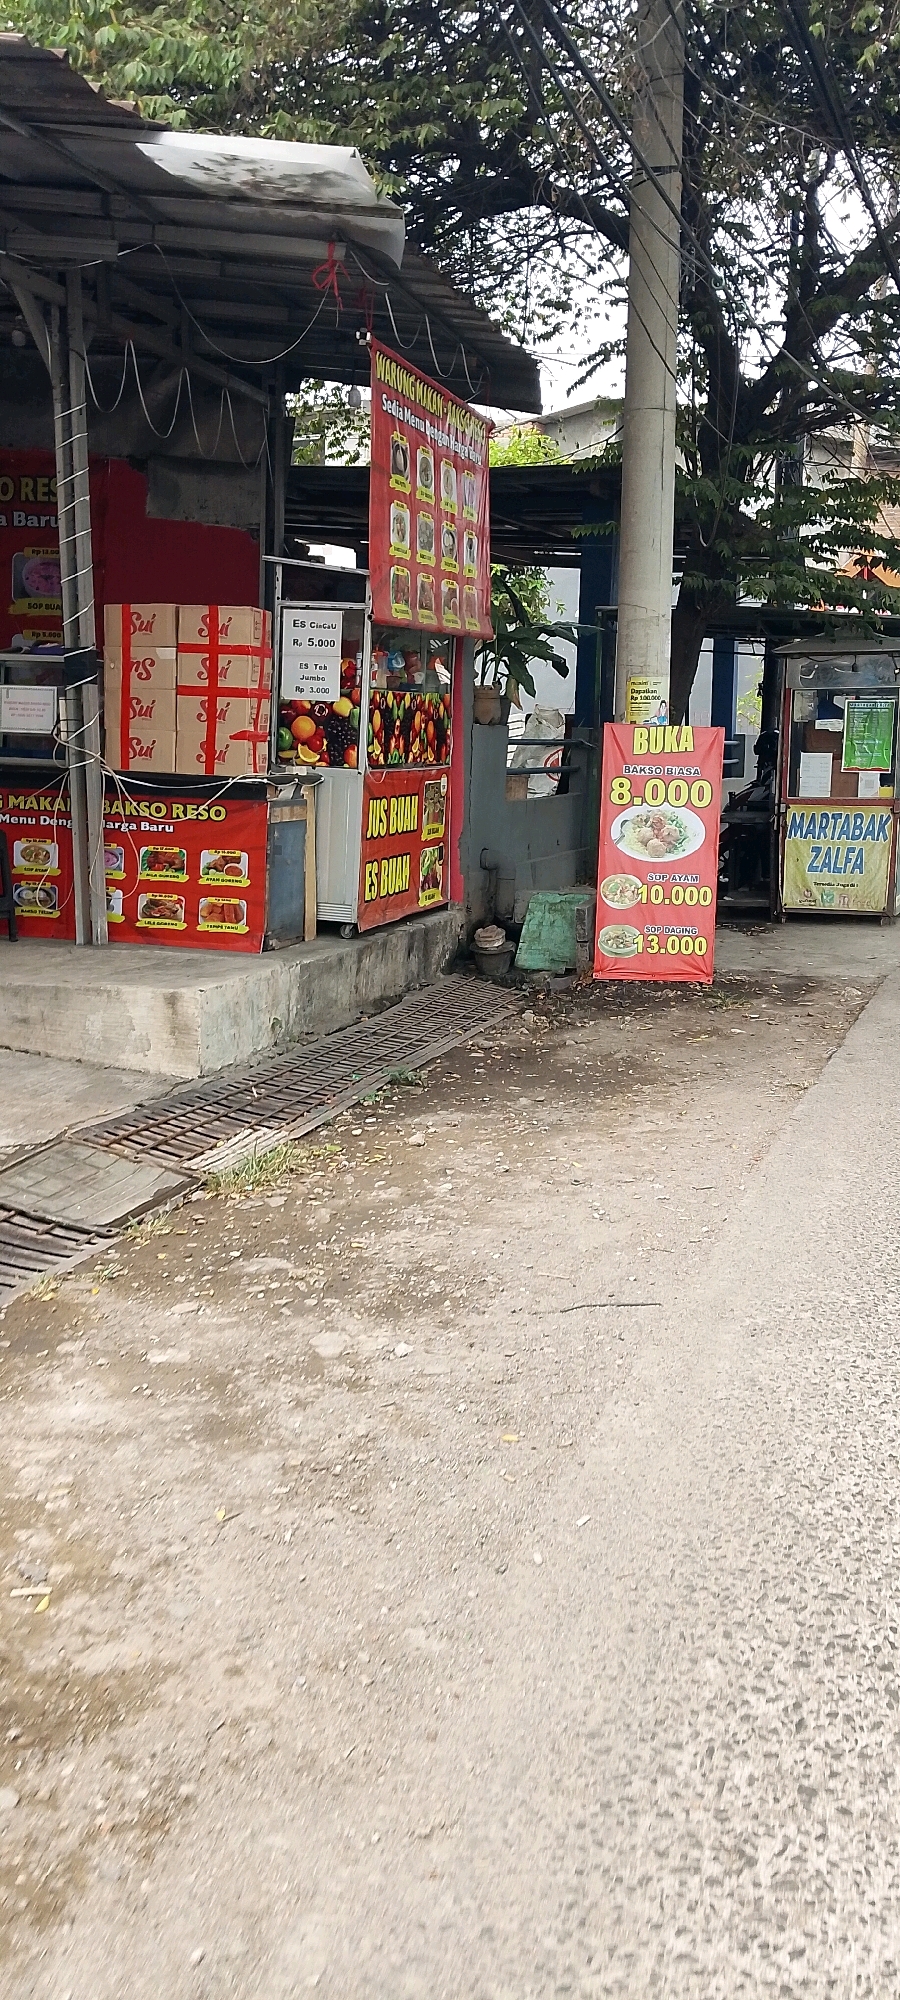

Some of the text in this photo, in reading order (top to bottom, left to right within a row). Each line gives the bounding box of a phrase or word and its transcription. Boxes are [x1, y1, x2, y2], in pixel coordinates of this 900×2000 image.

[375, 351, 415, 401] WARUNG
[416, 379, 444, 418] MAKAN
[382, 393, 403, 419] Sedia
[404, 407, 425, 432] Menu
[425, 419, 450, 447] Dengan
[449, 433, 469, 460] Harga
[20, 477, 58, 501] RES
[44, 603, 62, 611] BUA
[292, 619, 307, 629] ES
[292, 637, 336, 648] Rp 5.000
[299, 662, 309, 670] ES
[299, 674, 326, 682] Jumbo
[295, 686, 330, 694] Rp 3.000
[633, 725, 694, 755] BUKA
[624, 765, 701, 776] BAKSO BIASA
[610, 776, 713, 808] 8.000
[8, 795, 71, 811] MAKA
[172, 803, 227, 821] RESO
[366, 794, 419, 839] JUS BUAH
[0, 813, 36, 825] Menu
[140, 821, 174, 833] Baru
[787, 812, 892, 842] MARTABAK
[806, 845, 865, 875] ZALFA
[364, 854, 411, 902] ES BUAH
[648, 873, 699, 883] SOP AYAM
[638, 884, 713, 906] 10.000
[645, 926, 698, 935] SOP DAGING
[633, 934, 708, 956] 13.000
